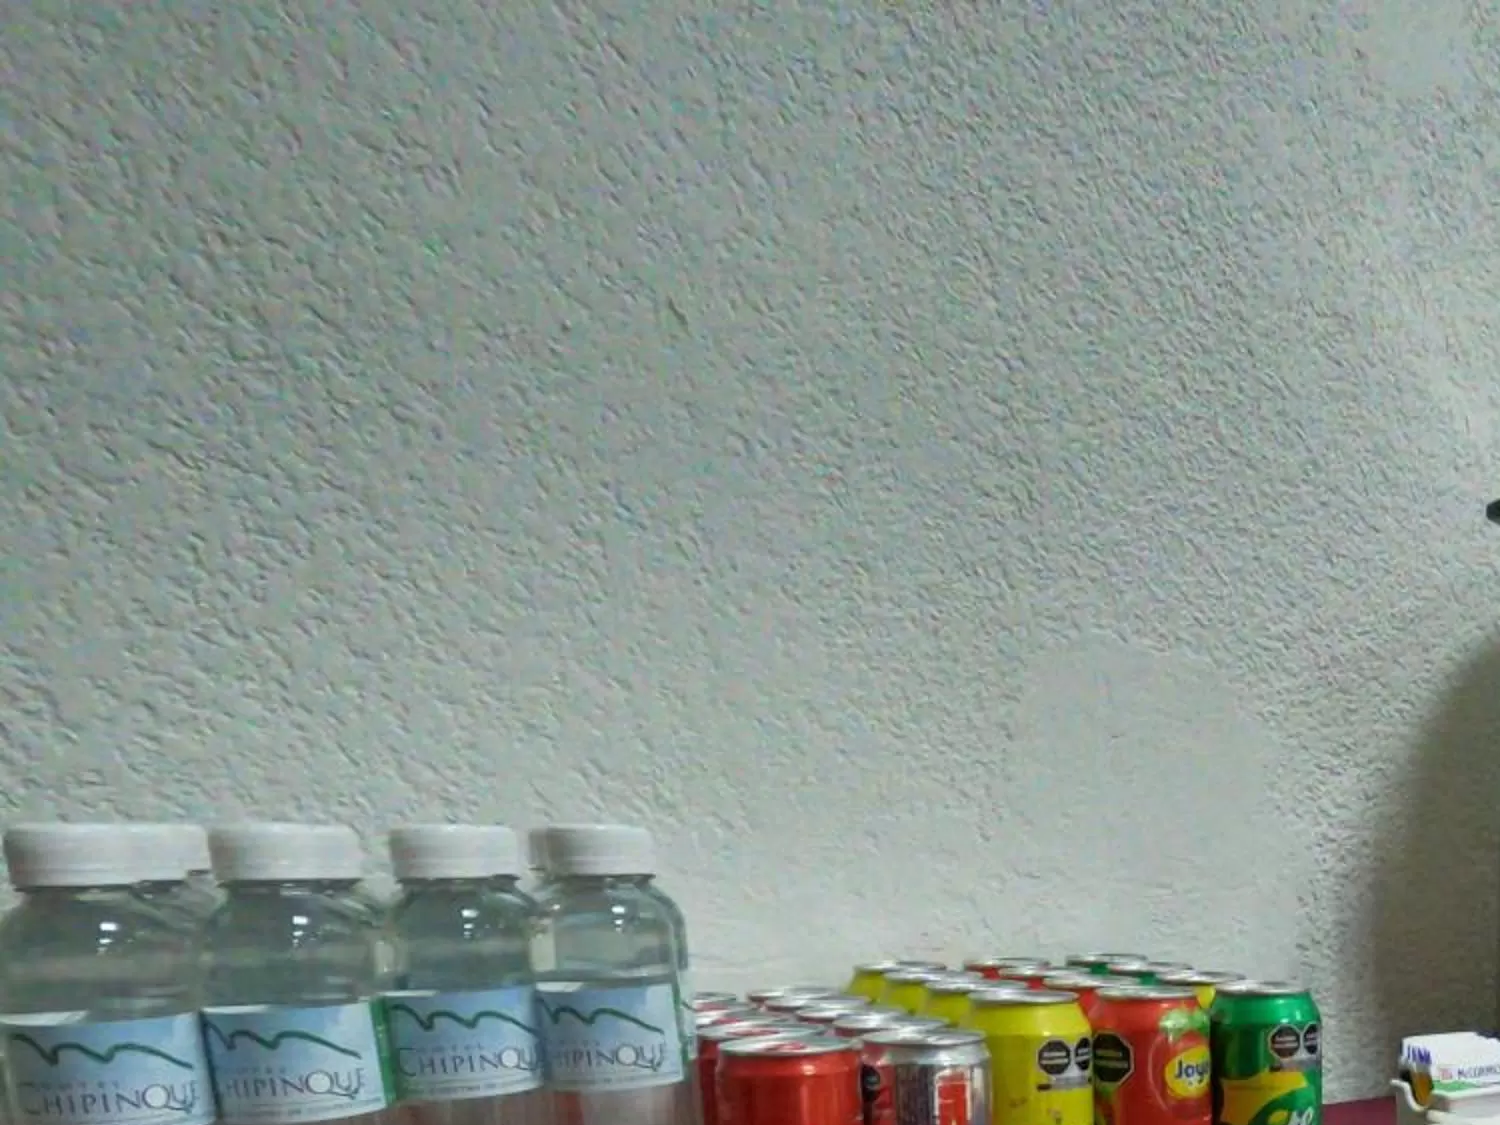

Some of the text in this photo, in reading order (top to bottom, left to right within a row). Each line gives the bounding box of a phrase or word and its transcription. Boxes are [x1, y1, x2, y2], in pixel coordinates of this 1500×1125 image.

[393, 1046, 540, 1078] CHIPINQU
[1175, 1059, 1209, 1084] Joy
[223, 1067, 364, 1101] HIPINQUE
